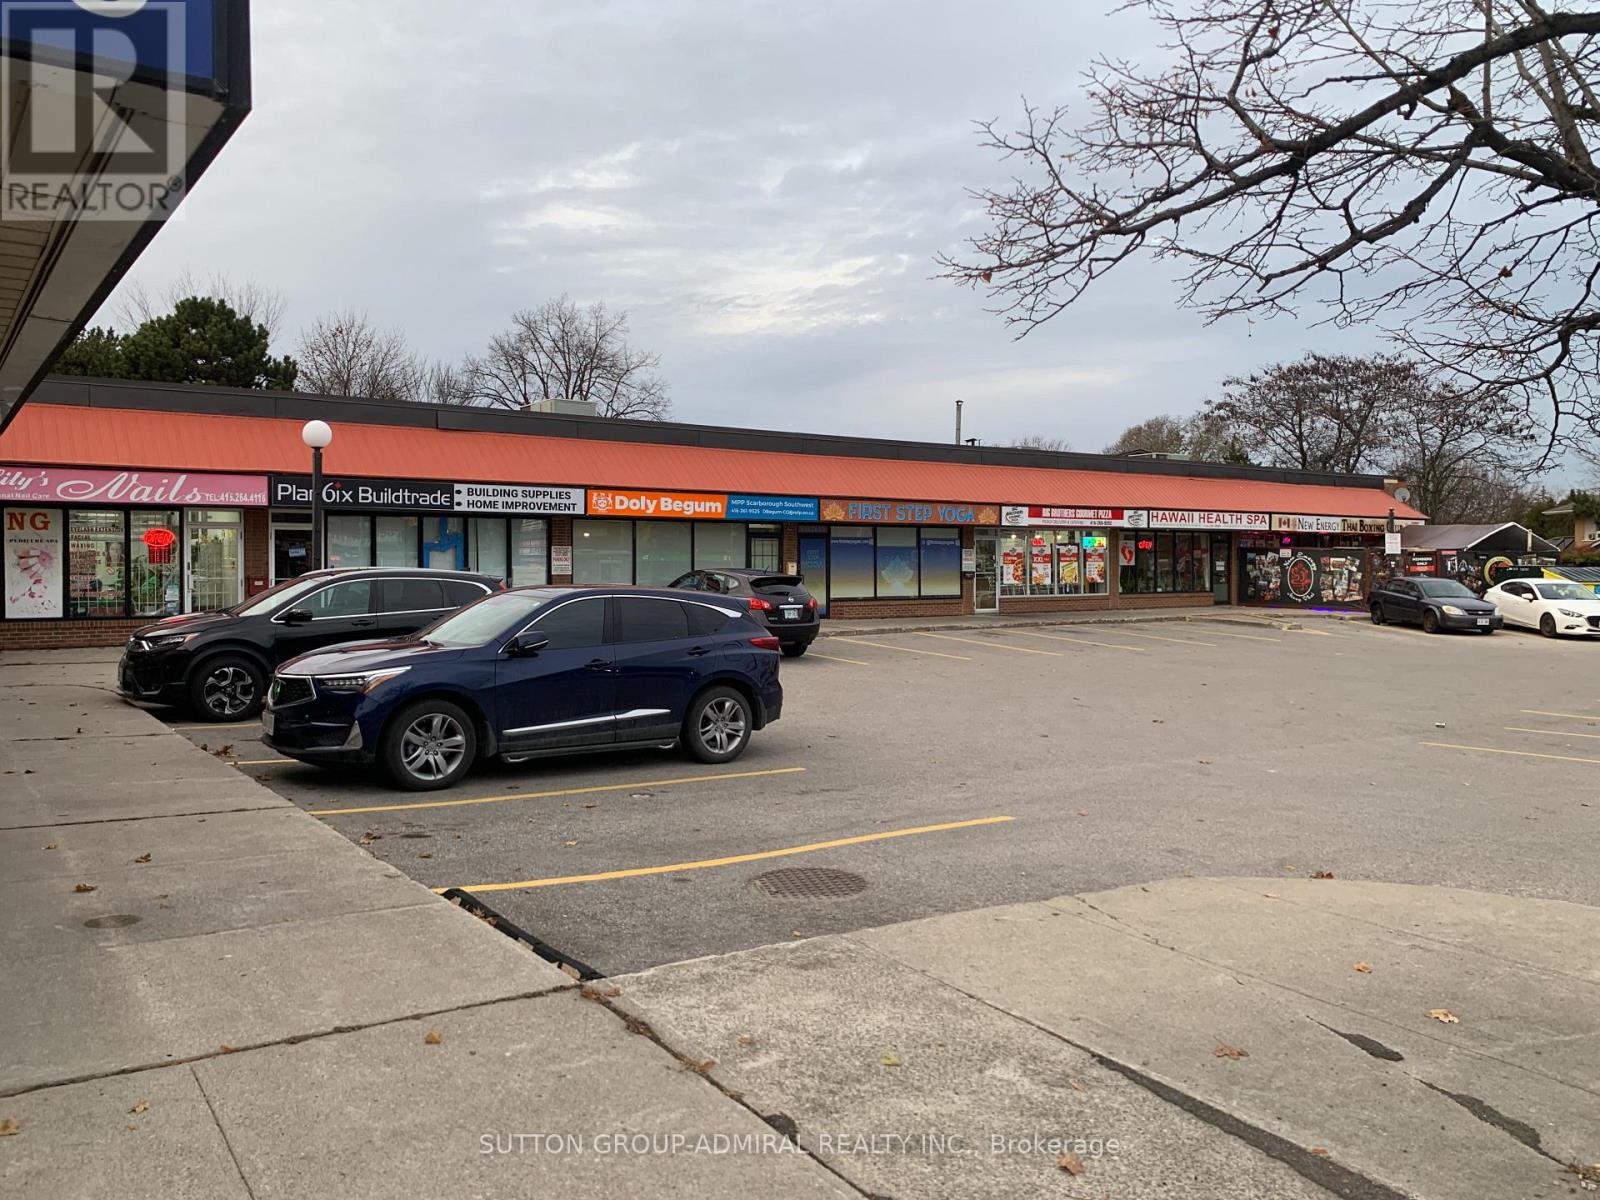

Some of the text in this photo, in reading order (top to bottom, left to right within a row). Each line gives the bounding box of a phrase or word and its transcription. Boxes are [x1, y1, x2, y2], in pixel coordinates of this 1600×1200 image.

[56, 472, 201, 502] Nails
[466, 487, 571, 500] BUILDING SUPPLIES
[358, 486, 451, 505] Buildtrade
[466, 499, 578, 512] HOME IMPROVEMENT
[615, 495, 722, 515] Doly Begum
[746, 500, 783, 508] Scarborough
[848, 503, 976, 522] FIRST STEP YOGA
[1151, 511, 1194, 523] HAWAII
[1199, 513, 1242, 524] HEALTH
[1246, 514, 1267, 525] SPA
[1297, 517, 1314, 530] NEW
[1316, 518, 1339, 531] ENERGY
[1342, 519, 1357, 532] THAI
[1359, 519, 1385, 532] BOXING
